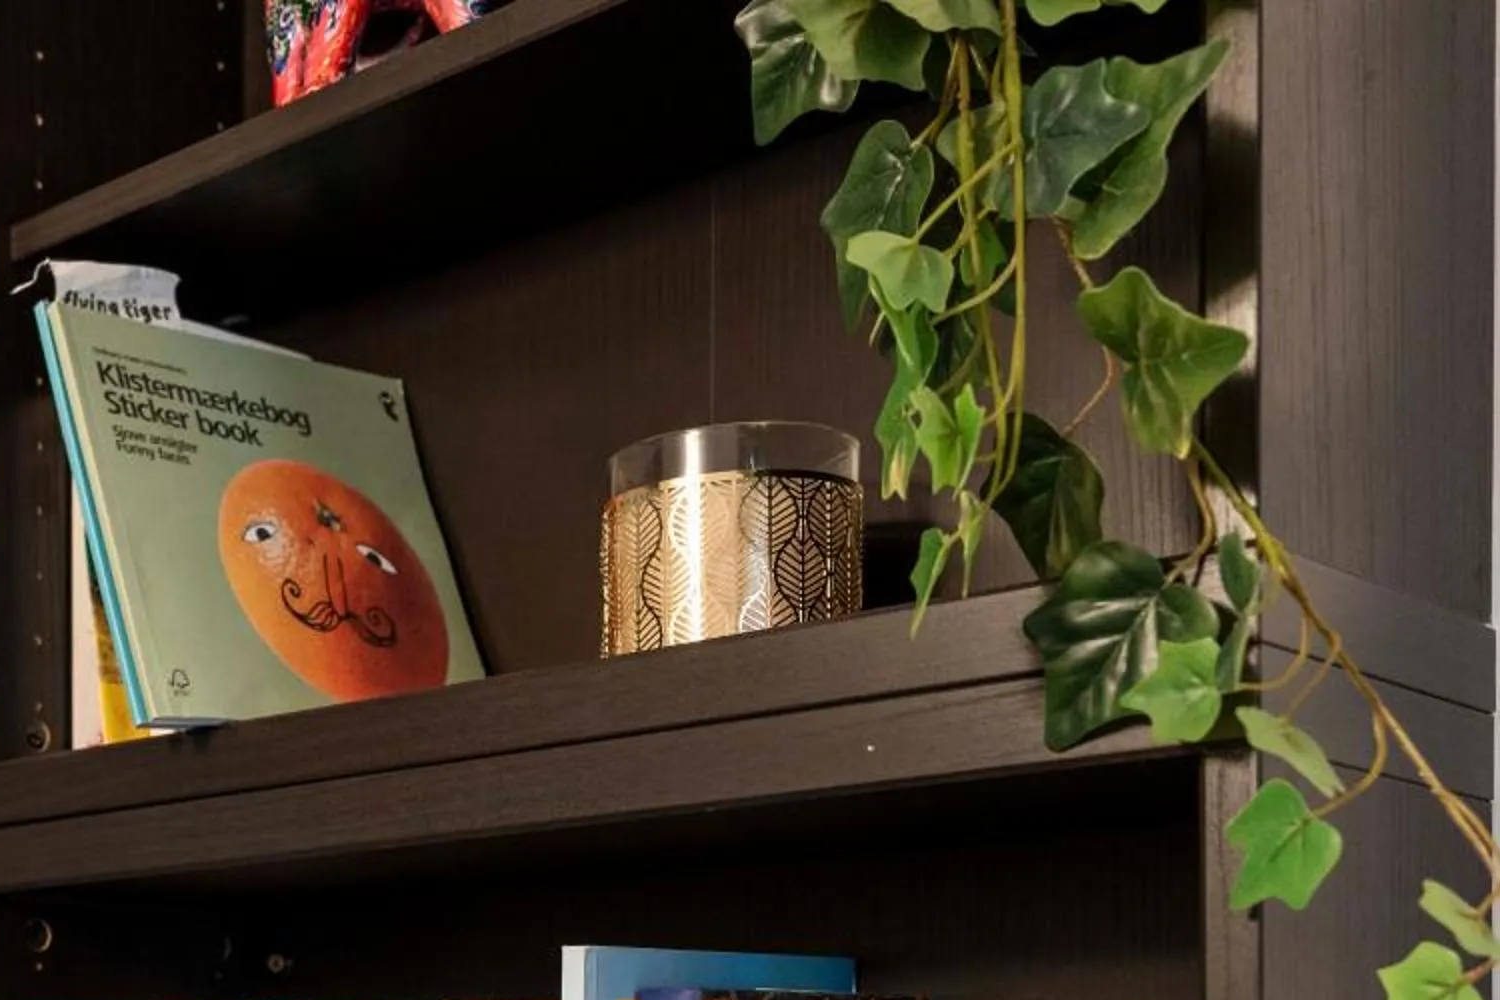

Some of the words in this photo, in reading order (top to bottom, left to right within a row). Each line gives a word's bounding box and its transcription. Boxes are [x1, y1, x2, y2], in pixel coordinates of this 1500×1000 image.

[122, 298, 172, 325] tiger
[96, 359, 312, 438] Klistermærkebog
[103, 389, 190, 431] Sticker
[194, 408, 264, 447] book
